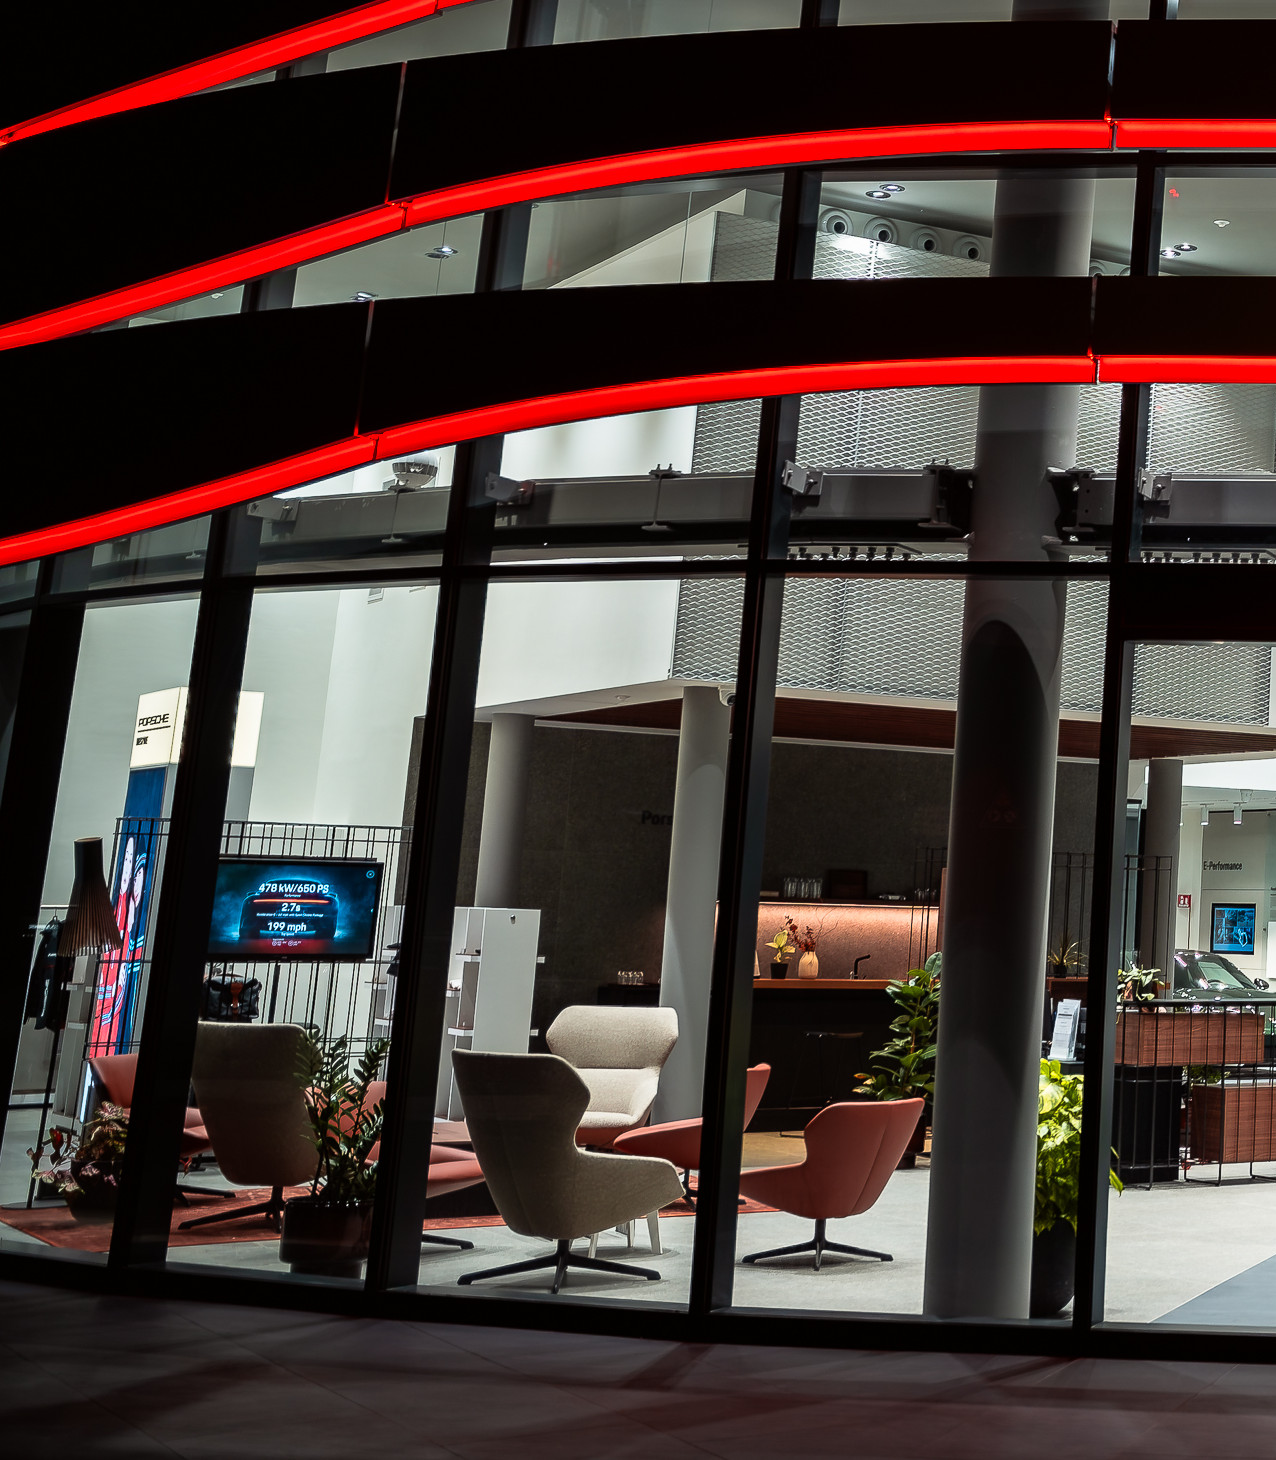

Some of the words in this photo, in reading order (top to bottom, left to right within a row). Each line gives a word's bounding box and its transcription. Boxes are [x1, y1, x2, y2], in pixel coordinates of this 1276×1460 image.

[1203, 860, 1243, 871] E-Performance
[258, 883, 278, 894] 478
[317, 884, 330, 894] PS
[281, 903, 301, 912] 2.7s
[267, 921, 285, 932] 199
[287, 922, 307, 934] mph
